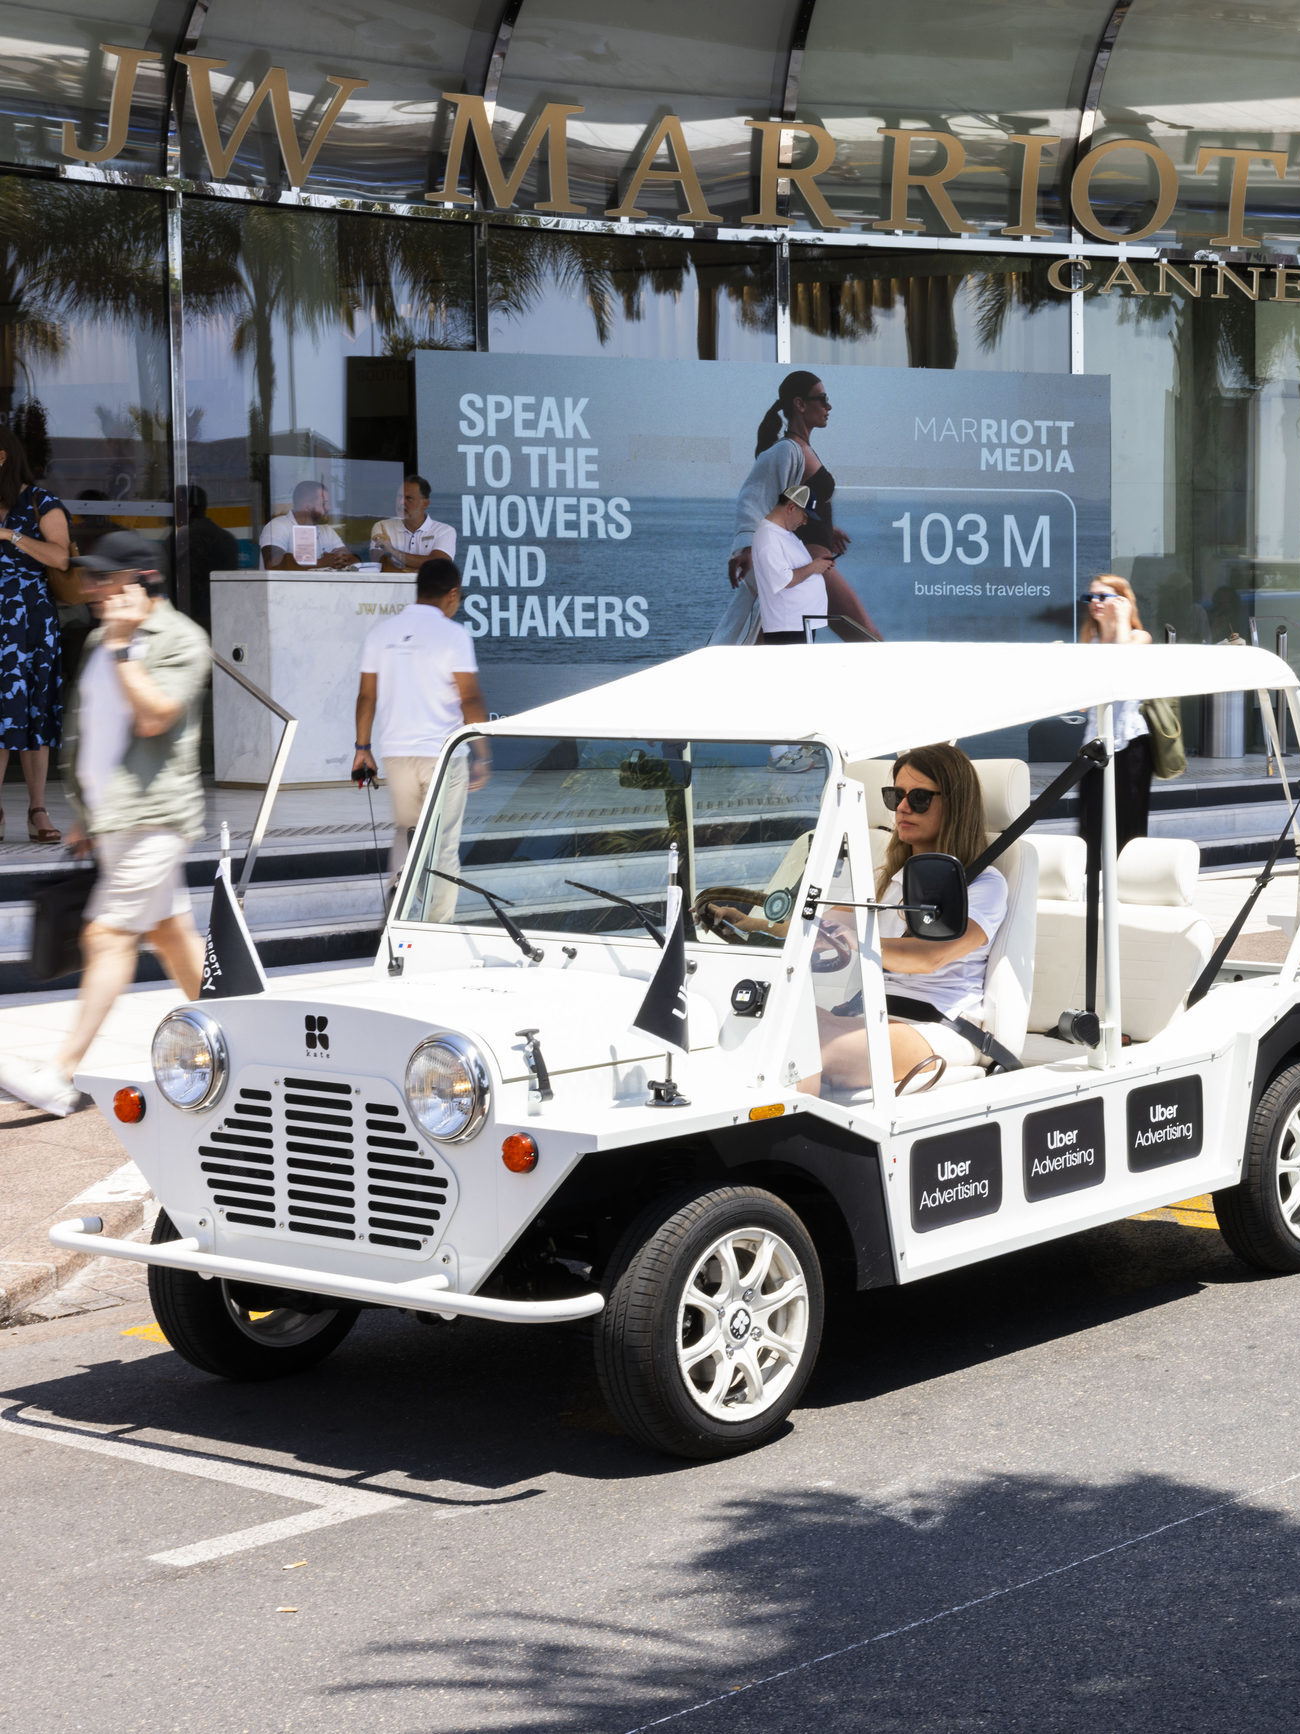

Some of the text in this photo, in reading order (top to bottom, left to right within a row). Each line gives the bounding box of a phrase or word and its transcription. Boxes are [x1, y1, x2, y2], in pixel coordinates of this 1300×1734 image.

[61, 44, 369, 191] JW
[458, 392, 592, 441] SPEAK
[914, 416, 1075, 446] MARRIOTT
[458, 444, 600, 490] TO THE
[979, 447, 1075, 474] MEDIA
[462, 495, 633, 541] MOVERS
[892, 511, 1052, 568] 103 M
[462, 545, 547, 589] AND
[914, 579, 1051, 598] business travelers
[379, 603, 409, 615] MAR
[464, 594, 650, 640] SHAKERS
[1149, 1102, 1178, 1123] Uber
[1047, 1128, 1078, 1150] Uber
[1134, 1121, 1193, 1148] Advertising
[937, 1158, 971, 1181] Uber
[1031, 1147, 1095, 1177] Advertising
[919, 1178, 989, 1211] Advertising
